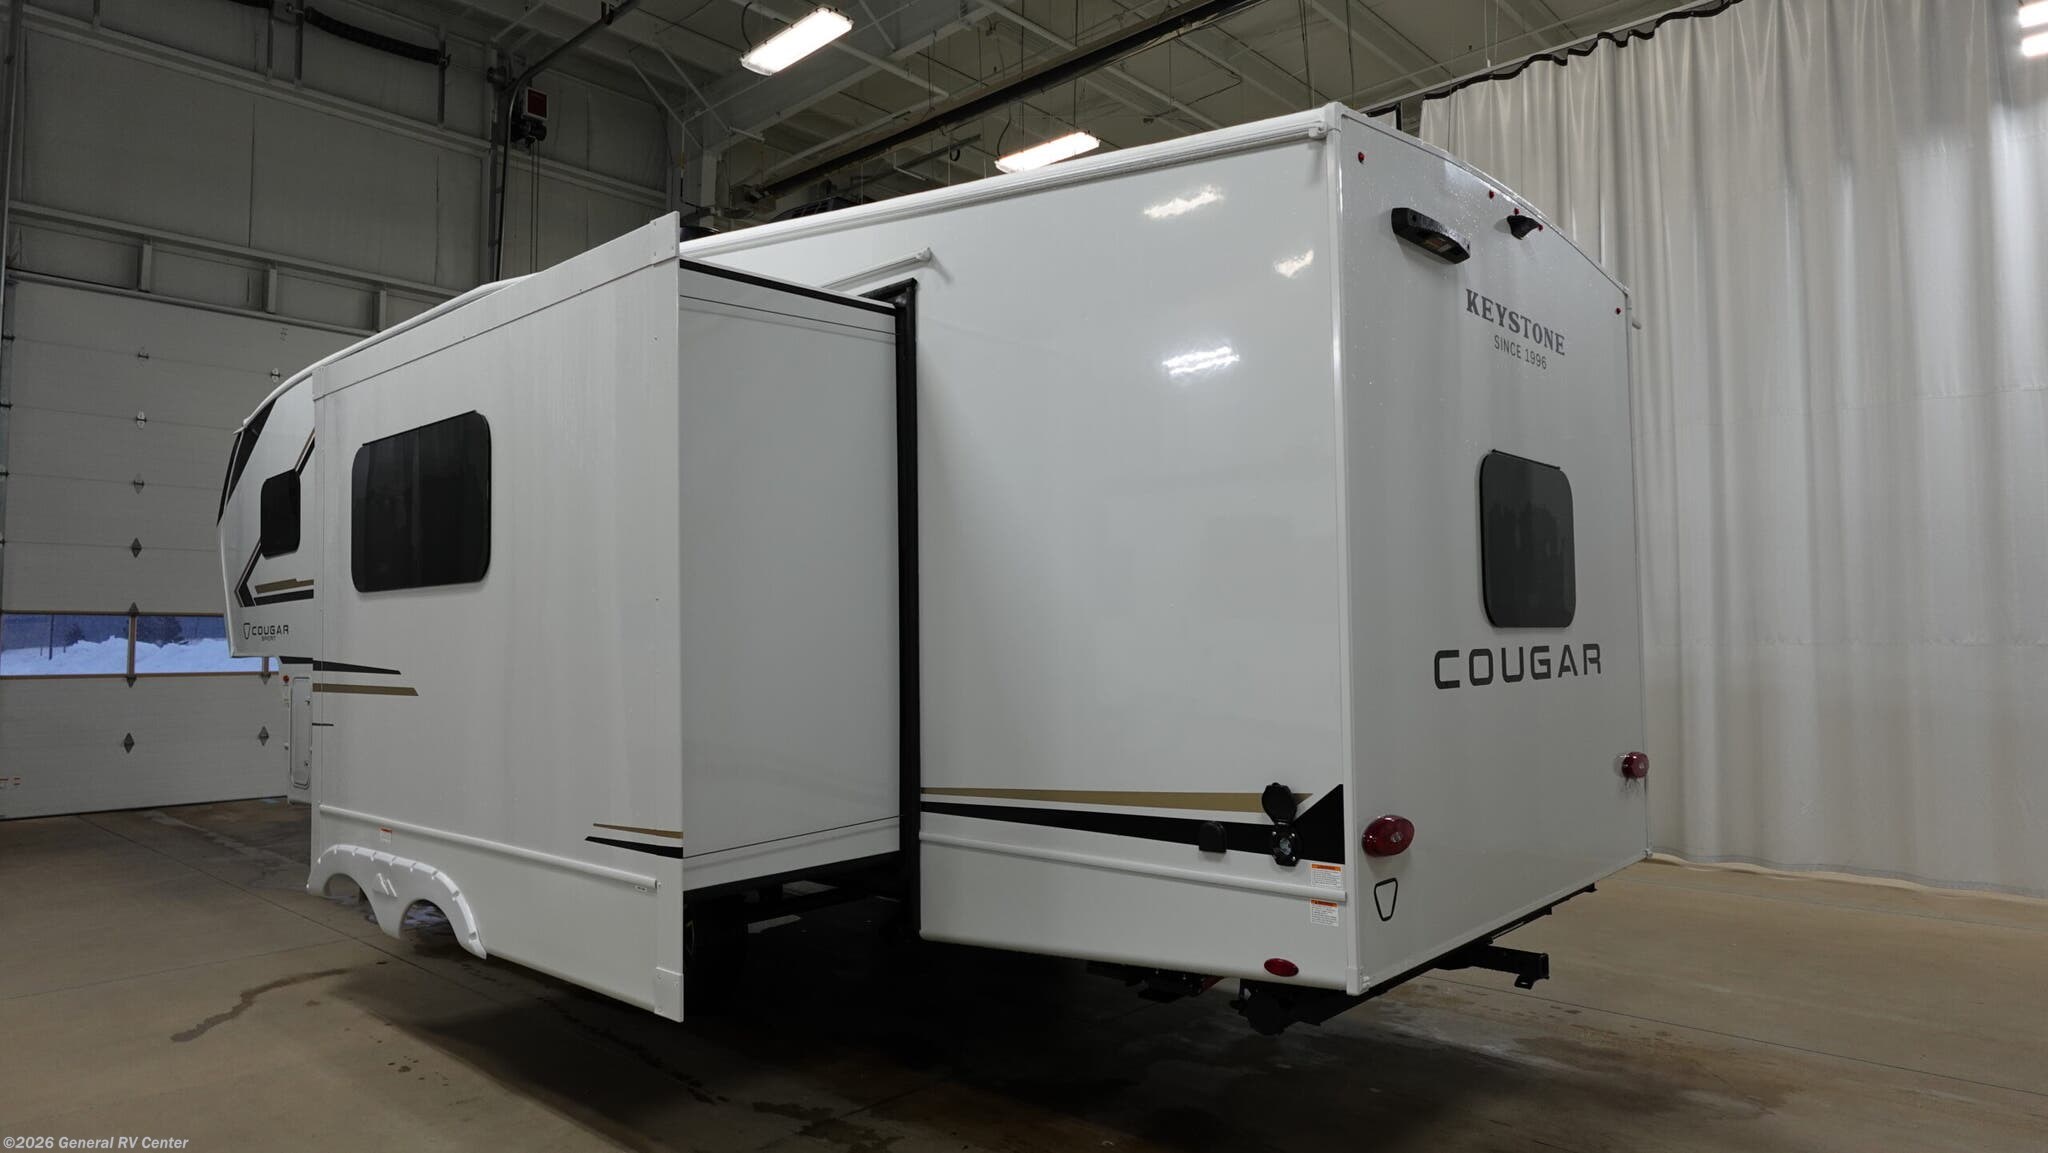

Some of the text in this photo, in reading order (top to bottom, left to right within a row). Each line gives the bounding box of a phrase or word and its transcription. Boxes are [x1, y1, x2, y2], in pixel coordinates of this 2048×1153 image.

[1466, 288, 1566, 356] KEYSTONE
[1494, 334, 1547, 370] SINCE 1996
[252, 624, 289, 636] COUGAR
[1434, 643, 1602, 690] COUGAR
